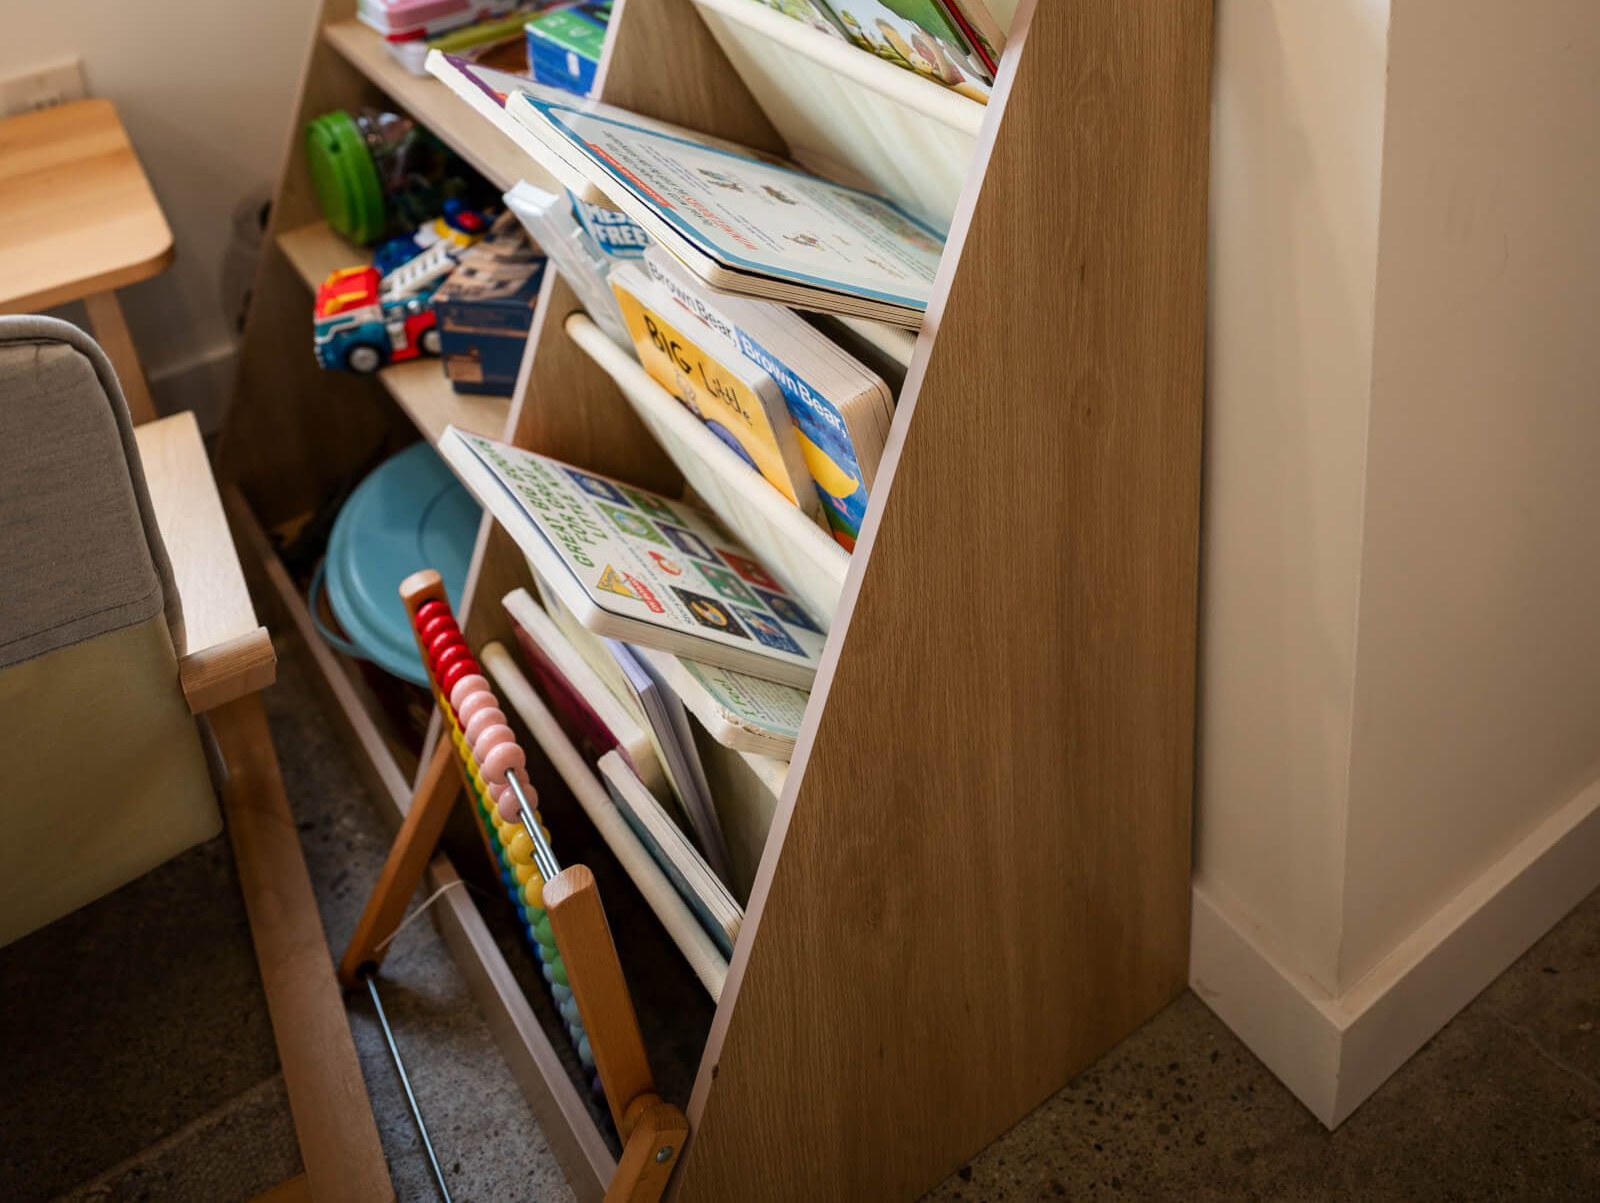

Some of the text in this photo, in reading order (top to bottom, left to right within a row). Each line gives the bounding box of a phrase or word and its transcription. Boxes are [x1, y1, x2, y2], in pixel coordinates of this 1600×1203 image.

[597, 225, 650, 246] FREE
[644, 314, 692, 374] BIG
[741, 335, 847, 438] Brown Bear,
[517, 484, 551, 511] BIG
[541, 513, 595, 568] GREAT
[559, 513, 597, 545] FOR
